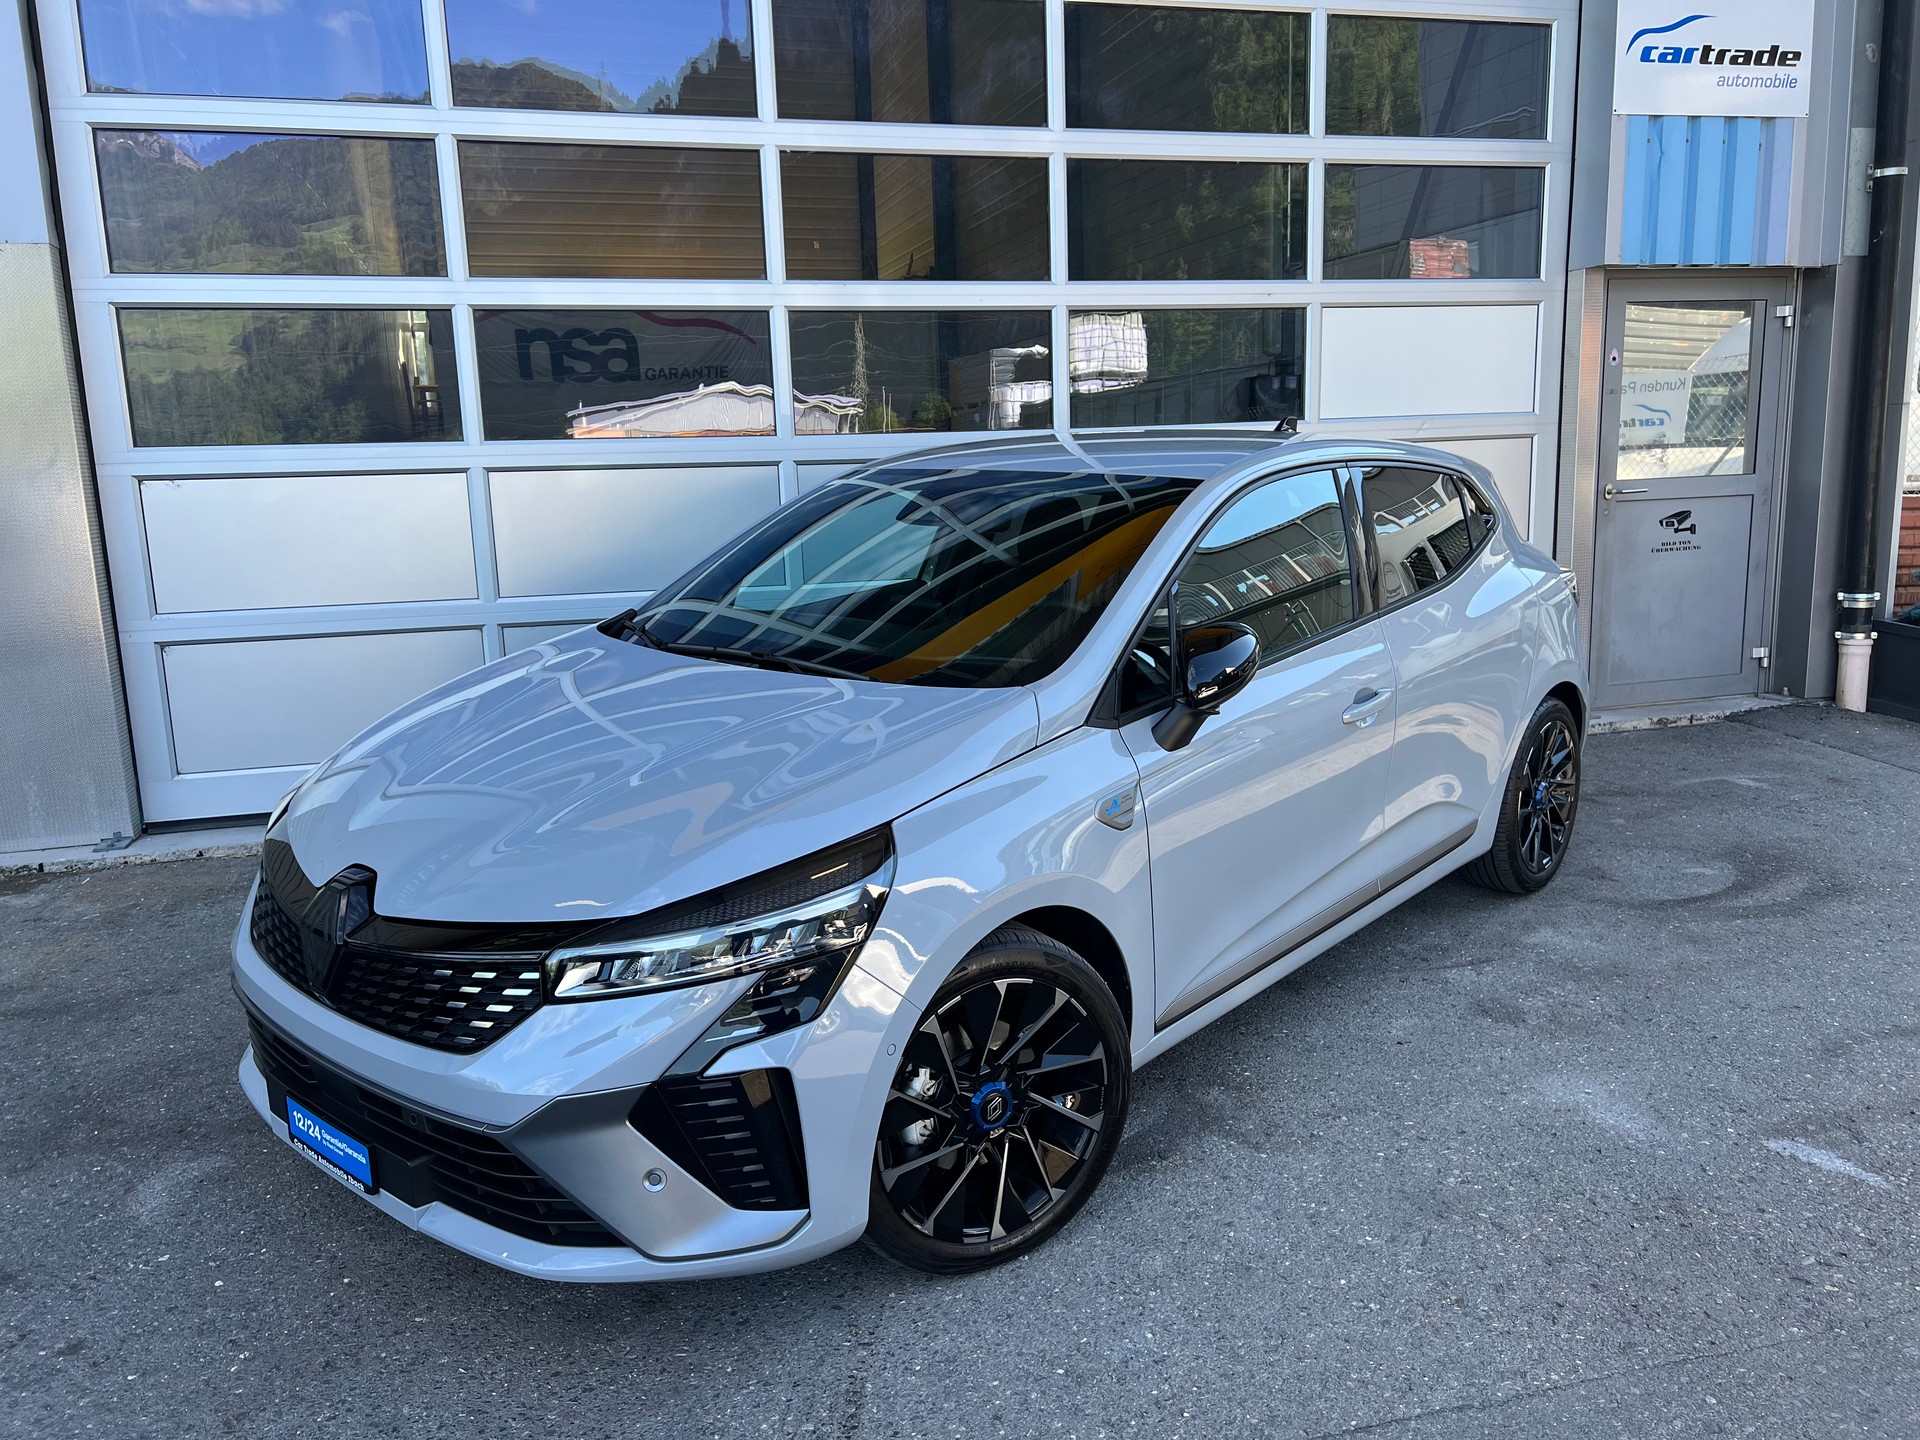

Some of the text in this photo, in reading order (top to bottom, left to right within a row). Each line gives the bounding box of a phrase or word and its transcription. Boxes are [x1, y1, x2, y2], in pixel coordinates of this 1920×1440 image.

[1639, 44, 1802, 68] cartrade
[1716, 73, 1798, 89] automobile
[514, 327, 729, 382] nsa GARANTIE
[293, 1110, 321, 1141] 12/24
[293, 1138, 303, 1150] Car
[303, 1144, 318, 1160] Trade
[318, 1155, 347, 1181] Automobile
